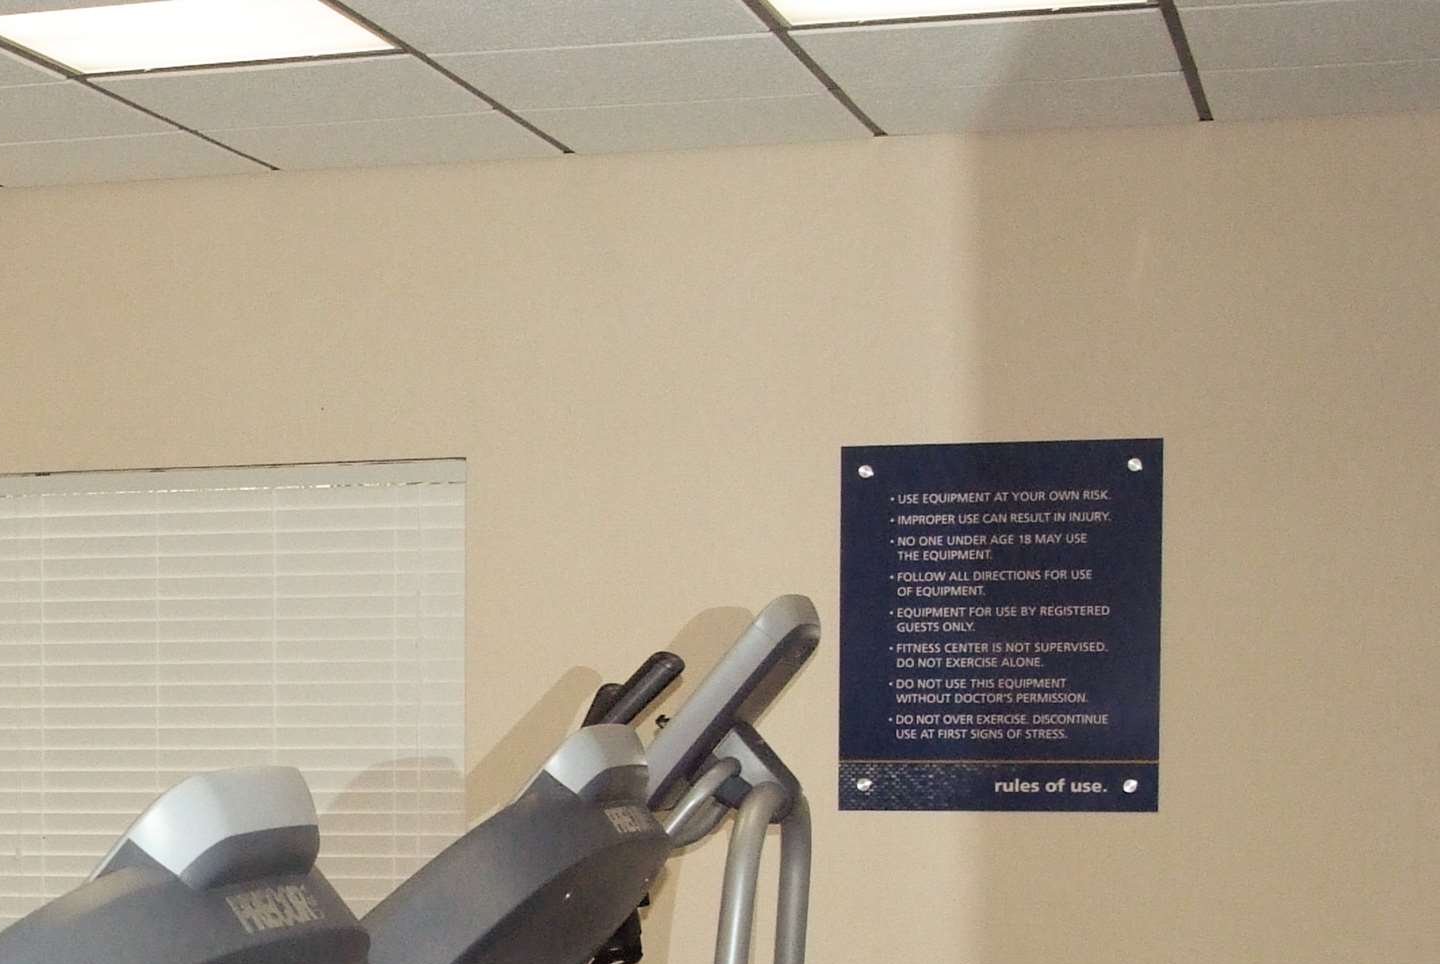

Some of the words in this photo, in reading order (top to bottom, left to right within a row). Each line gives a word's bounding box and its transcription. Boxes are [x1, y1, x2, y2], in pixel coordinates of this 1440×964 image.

[898, 494, 918, 504] USE
[923, 492, 991, 504] EQUIPMENT
[995, 492, 1010, 503] AT
[1013, 491, 1046, 502] YOUR
[1049, 490, 1079, 502] OWN
[1082, 489, 1111, 501] RISK.
[898, 514, 955, 525] IMPROPER
[959, 514, 980, 524] USE
[982, 513, 1006, 524] CAN
[1010, 513, 1050, 524] RESULT
[1053, 512, 1065, 523] IN
[1069, 512, 1111, 523] INJURY.
[898, 536, 915, 546] NO
[919, 536, 943, 546] ONE
[947, 535, 987, 545] UNDER
[991, 535, 1014, 545] AGE
[1019, 534, 1031, 544] 18
[1035, 534, 1062, 544] MAY
[1066, 533, 1087, 544] USE
[898, 551, 919, 561] THE
[897, 572, 946, 582] FOLLOW
[949, 572, 970, 581] ALL
[973, 570, 1041, 581] DIRECTIONS
[1045, 570, 1067, 580] FOR
[1071, 570, 1093, 580] USE
[897, 587, 912, 597] OF
[897, 608, 966, 619] EQUIPMENT
[969, 607, 991, 618] FOR
[996, 607, 1017, 617] USE
[1021, 607, 1036, 617] BY
[1040, 606, 1110, 617] REGISTERED
[897, 622, 939, 632] GUESTS
[943, 622, 975, 632] ONLY.
[896, 643, 940, 653] FITNESS
[944, 643, 988, 653] CENTER
[992, 643, 1002, 652] IS
[1006, 643, 1031, 652] NOT
[1034, 642, 1108, 652] SUPERVISED.
[896, 658, 914, 668] DO
[918, 658, 943, 668] NOT
[946, 658, 998, 668] EXERCISE
[1001, 657, 1043, 667] ALONE.
[896, 679, 914, 689] DO
[917, 679, 942, 689] NOT
[945, 679, 967, 689] USE
[970, 679, 995, 689] THIS
[998, 678, 1066, 689] EQUIPMENT
[896, 694, 951, 703] WITHOUT
[896, 715, 913, 725] DO
[916, 715, 940, 725] NOT
[943, 715, 973, 725] OVER
[1033, 714, 1108, 724] DISCONTINUE
[896, 729, 917, 739] USE
[921, 729, 935, 739] AT
[938, 729, 967, 739] FIRST
[970, 729, 1003, 739] SIGNS
[1007, 729, 1022, 739] OF
[1025, 729, 1067, 739] STRESS.
[995, 779, 1039, 793] rules
[1045, 779, 1065, 793] of
[1071, 782, 1107, 793] use.
